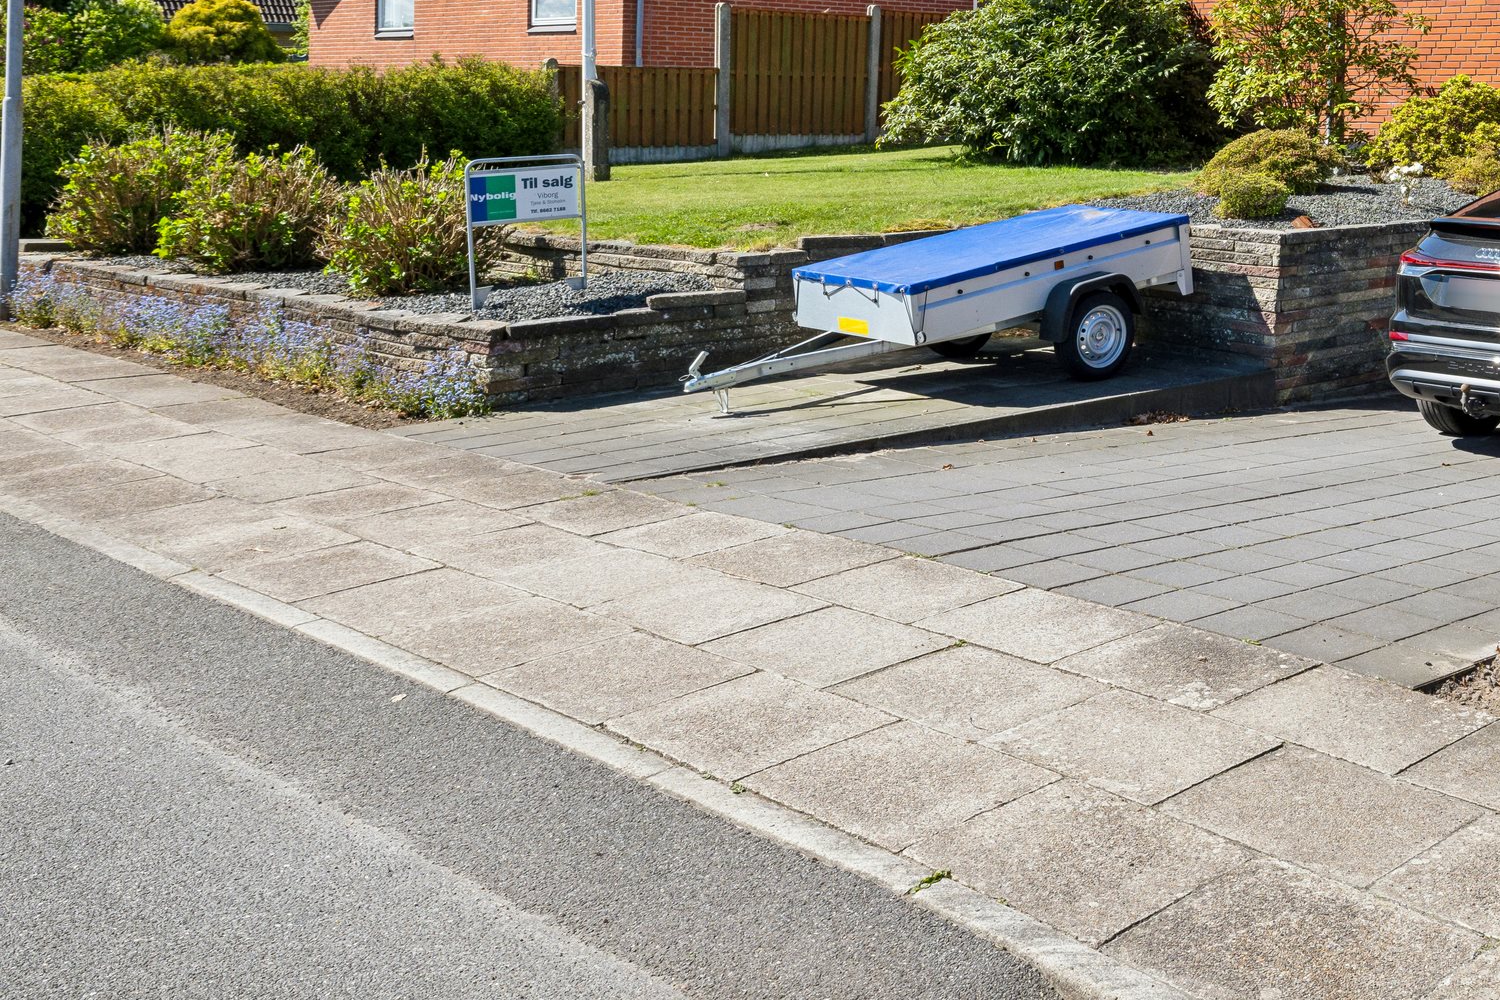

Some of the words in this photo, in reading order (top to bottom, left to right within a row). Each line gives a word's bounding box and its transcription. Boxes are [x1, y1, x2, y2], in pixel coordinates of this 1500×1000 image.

[521, 177, 538, 189] Til
[542, 175, 573, 189] salg
[471, 191, 517, 203] Nybolig
[537, 191, 559, 199] Viborg
